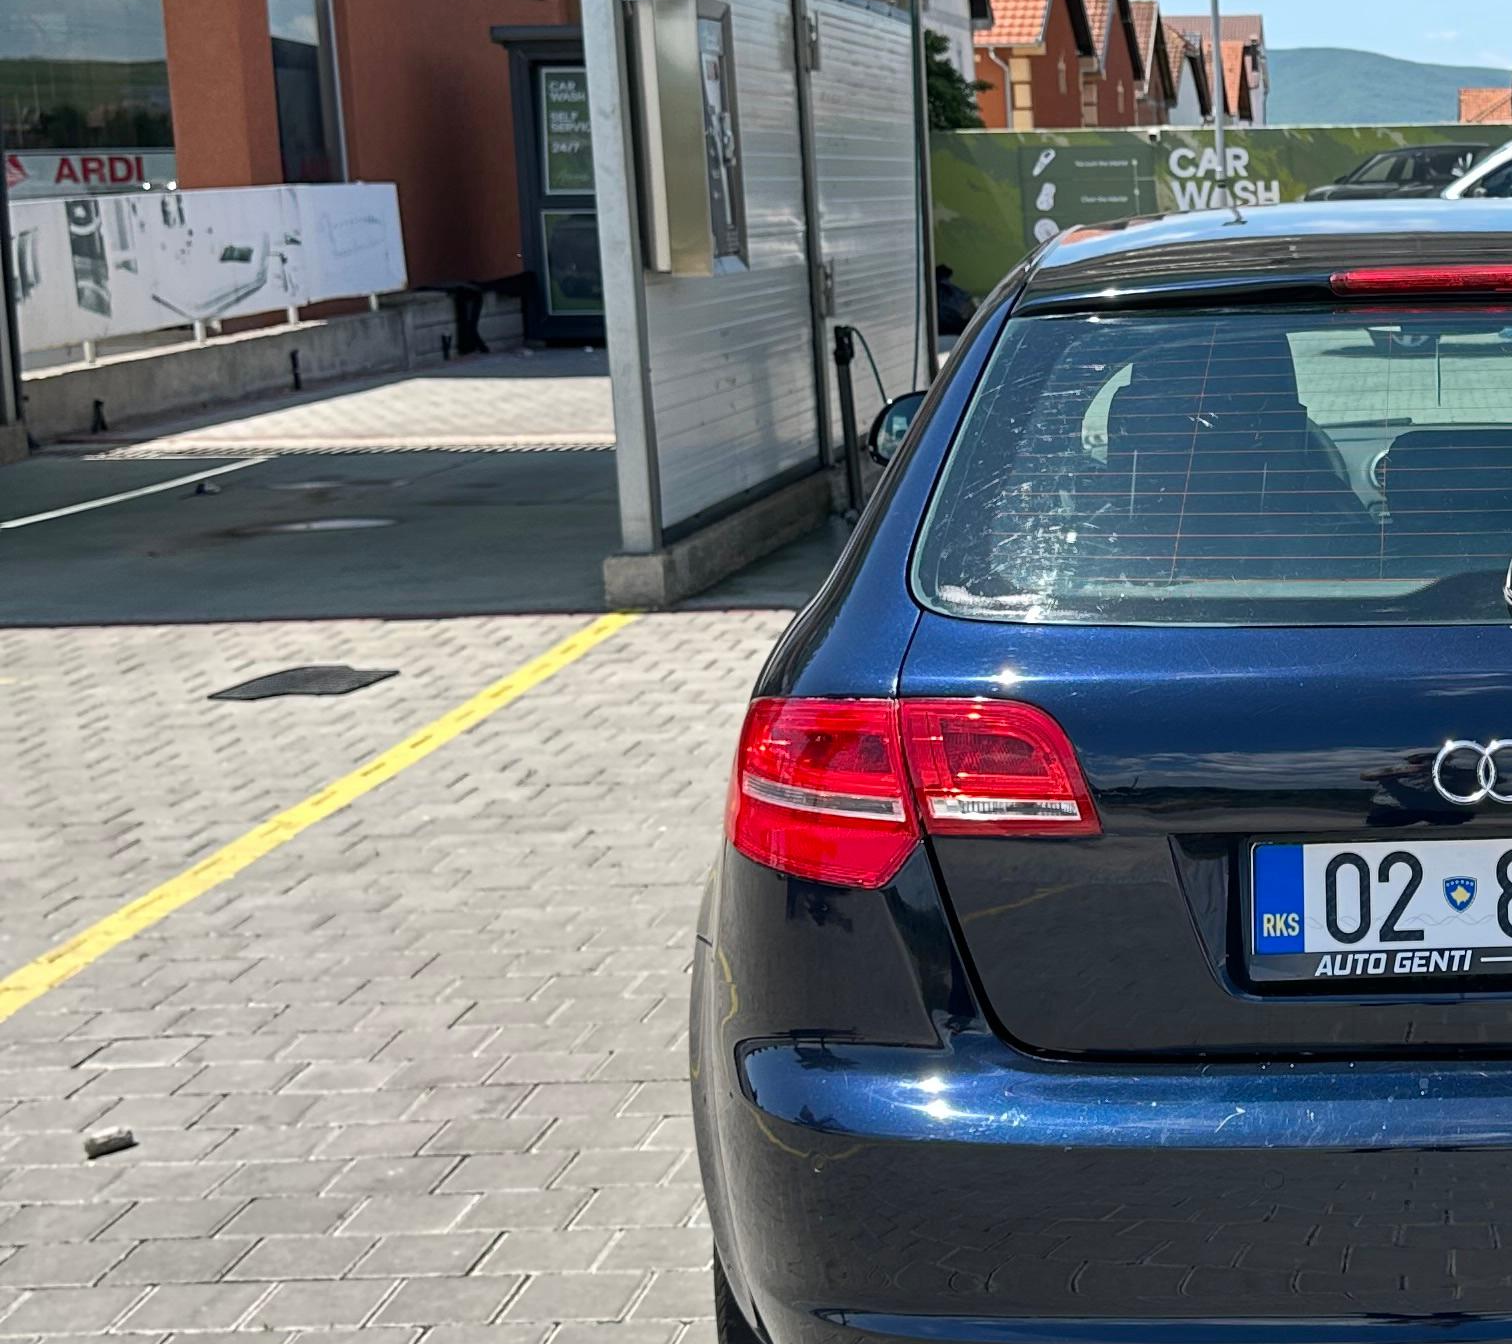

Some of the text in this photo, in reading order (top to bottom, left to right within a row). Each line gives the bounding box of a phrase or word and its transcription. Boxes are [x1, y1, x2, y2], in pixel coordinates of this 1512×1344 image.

[55, 156, 145, 184] ARDI
[1169, 147, 1249, 178] CAR
[1171, 180, 1280, 211] WASH
[1324, 851, 1425, 944] 02
[1262, 913, 1300, 937] RKS
[1314, 949, 1472, 976] AUTO GENTI
